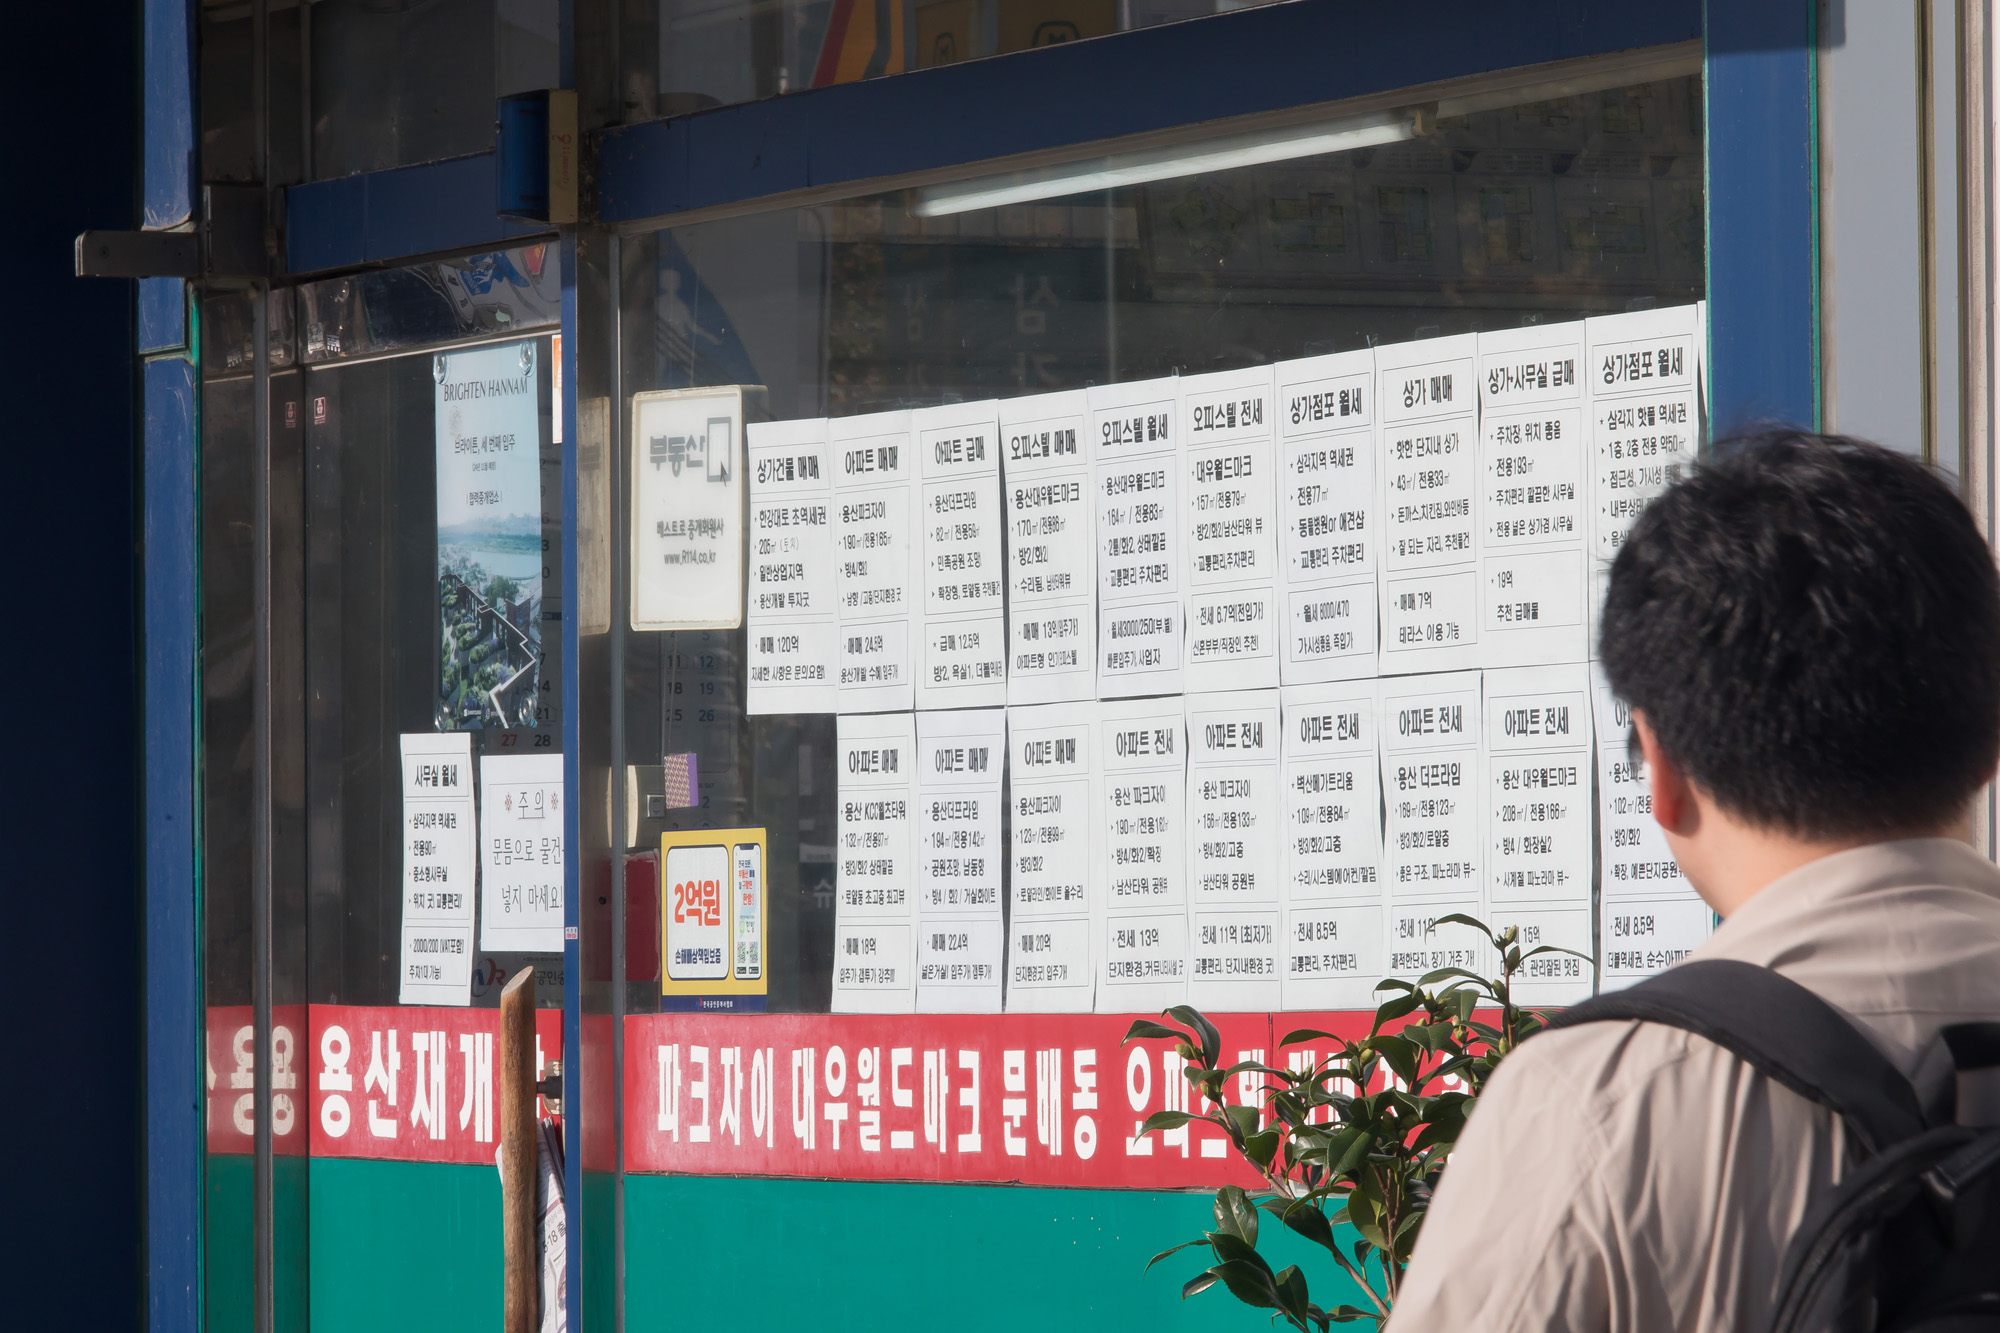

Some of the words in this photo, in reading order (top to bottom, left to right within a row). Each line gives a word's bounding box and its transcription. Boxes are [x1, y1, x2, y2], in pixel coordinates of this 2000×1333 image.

[1552, 359, 1574, 387] 급매
[1602, 351, 1653, 384] 상가점포
[1658, 347, 1683, 377] 월세
[443, 381, 487, 402] BRIGHTEN
[488, 377, 528, 396] HANNAM
[1403, 378, 1426, 408] 상가
[1430, 374, 1452, 403] 매매
[1194, 402, 1236, 431] 오피스텔
[1241, 398, 1262, 426] 전세
[1290, 392, 1334, 424] 상가점포
[1339, 387, 1362, 416] 월세
[1608, 408, 1634, 430] 삼각지
[1659, 402, 1686, 424] 역세권
[1102, 417, 1143, 446] 오피스텔
[1147, 413, 1168, 441] 월세
[1525, 422, 1541, 442] 위치
[1545, 420, 1561, 441] 좋음
[481, 436, 488, 453] 세
[489, 436, 501, 453] 번째
[502, 434, 515, 451] 입주
[935, 439, 963, 465] 아파트
[966, 436, 985, 462] 급매
[1011, 432, 1050, 460] 오피스텔
[1054, 429, 1076, 455] 매매
[1397, 439, 1413, 460] 핫한
[1416, 435, 1441, 457] 단지내
[1444, 432, 1459, 454] 상가
[1642, 437, 1657, 456] 전용
[649, 434, 705, 478] 부동산
[845, 449, 874, 475] 아파트
[878, 446, 898, 471] 매매
[1297, 451, 1327, 474] 삼각지역
[1330, 447, 1353, 468] 역세권
[757, 457, 794, 483] 상가건물
[798, 455, 819, 480] 매매
[1197, 455, 1252, 483] 대우월드마크
[1639, 466, 1664, 488] 가시성
[1107, 470, 1164, 496] 용산대우월드마크
[935, 491, 976, 513] 용산더프라임
[1016, 483, 1079, 509] 용산대우월드마크
[1496, 487, 1524, 506] 주차편리
[1527, 485, 1550, 503] 깔끔한
[1552, 483, 1574, 501] 사무실
[760, 508, 789, 528] 한강대로
[792, 506, 826, 526] 초역세권
[842, 501, 885, 523] 용산파크자이
[1497, 521, 1510, 537] 전용
[1528, 517, 1549, 535] 상가겸
[1552, 515, 1573, 532] 사무실
[1301, 547, 1329, 569] 교통편리
[1332, 543, 1364, 565] 주차편리
[1399, 539, 1406, 556] 잘
[1408, 538, 1423, 555] 되는
[760, 563, 804, 582] 일반상업지역
[1139, 563, 1168, 584] 주차편리
[1498, 570, 1513, 588] 19억
[760, 593, 785, 609] 용산개발
[1400, 593, 1415, 611] 매매
[1418, 591, 1431, 609] 7억
[1497, 604, 1512, 622] 추천
[1515, 602, 1538, 621] 급매물
[1200, 606, 1214, 625] 전세
[1304, 603, 1318, 623] 월세
[1023, 622, 1039, 641] 매매
[1399, 625, 1423, 644] 테라스
[1427, 623, 1443, 641] 이용
[1446, 622, 1459, 639] 가능
[940, 635, 956, 651] 급매
[1017, 653, 1044, 670] 아파트형
[751, 666, 770, 681] 자세한
[1301, 716, 1332, 744] 아파트
[1337, 713, 1359, 741] 전세
[1399, 708, 1434, 736] 아파트
[1439, 705, 1462, 733] 전세
[1505, 709, 1540, 737] 아파트
[1545, 706, 1569, 735] 전세
[501, 733, 517, 747] 27
[534, 734, 551, 747] 28
[1116, 731, 1149, 758] 아파트
[1154, 728, 1173, 755] 전세
[1206, 724, 1236, 750] 아파트
[1241, 722, 1263, 748] 전세
[849, 750, 879, 775] 아파트
[882, 749, 898, 773] 매매
[935, 749, 964, 774] 아파트
[969, 747, 988, 773] 매매
[1025, 740, 1051, 767] 아파트
[1055, 738, 1076, 764] 매매
[415, 765, 438, 787] 사무실
[442, 765, 457, 787] 월세
[1297, 772, 1353, 794] 벽산메가트리움
[1398, 766, 1417, 791] 용산
[1420, 762, 1460, 788] 더프라임
[1503, 770, 1519, 790] 용산
[1523, 767, 1577, 789] 대우월드마크
[1115, 787, 1131, 807] 용산
[1133, 785, 1165, 805] 파크자이
[1203, 781, 1217, 800] 용산
[1220, 779, 1250, 799] 파크자이
[845, 802, 862, 822] 용산
[932, 800, 978, 822] 용산더프라임
[1020, 795, 1061, 816] 용산파크자이
[413, 813, 436, 829] 삼각지역
[438, 813, 456, 829] 역세권
[493, 839, 534, 865] 문틈으로
[540, 837, 564, 864] 물건
[413, 866, 447, 882] 중소형사무실
[1204, 873, 1228, 890] 남산타워
[1400, 865, 1411, 882] 좋은
[1432, 862, 1461, 880] 파노라마
[1503, 871, 1524, 887] 사계절
[1527, 870, 1554, 887] 파노라마
[1117, 878, 1149, 895] 남산타워
[414, 893, 425, 909] 위치
[502, 885, 521, 913] 넣지
[674, 879, 721, 927] 2억원
[1202, 926, 1216, 944] 전세
[1298, 922, 1313, 942] 전세
[1400, 919, 1414, 938] 전세
[1615, 916, 1630, 937] 전세
[932, 934, 945, 951] 매매
[1022, 935, 1034, 953] 매매
[1117, 929, 1135, 948] 전세
[1140, 928, 1159, 947] 13억
[1323, 953, 1357, 971] 주차편리
[1431, 951, 1448, 971] 장기
[1446, 951, 1464, 970] 거주
[1530, 959, 1561, 977] 관리잘된
[319, 1024, 544, 1143] 용산재개
[657, 1043, 774, 1149] 파크자이
[791, 1044, 982, 1154] 대우월드마크
[1002, 1047, 1098, 1161] 문배동
